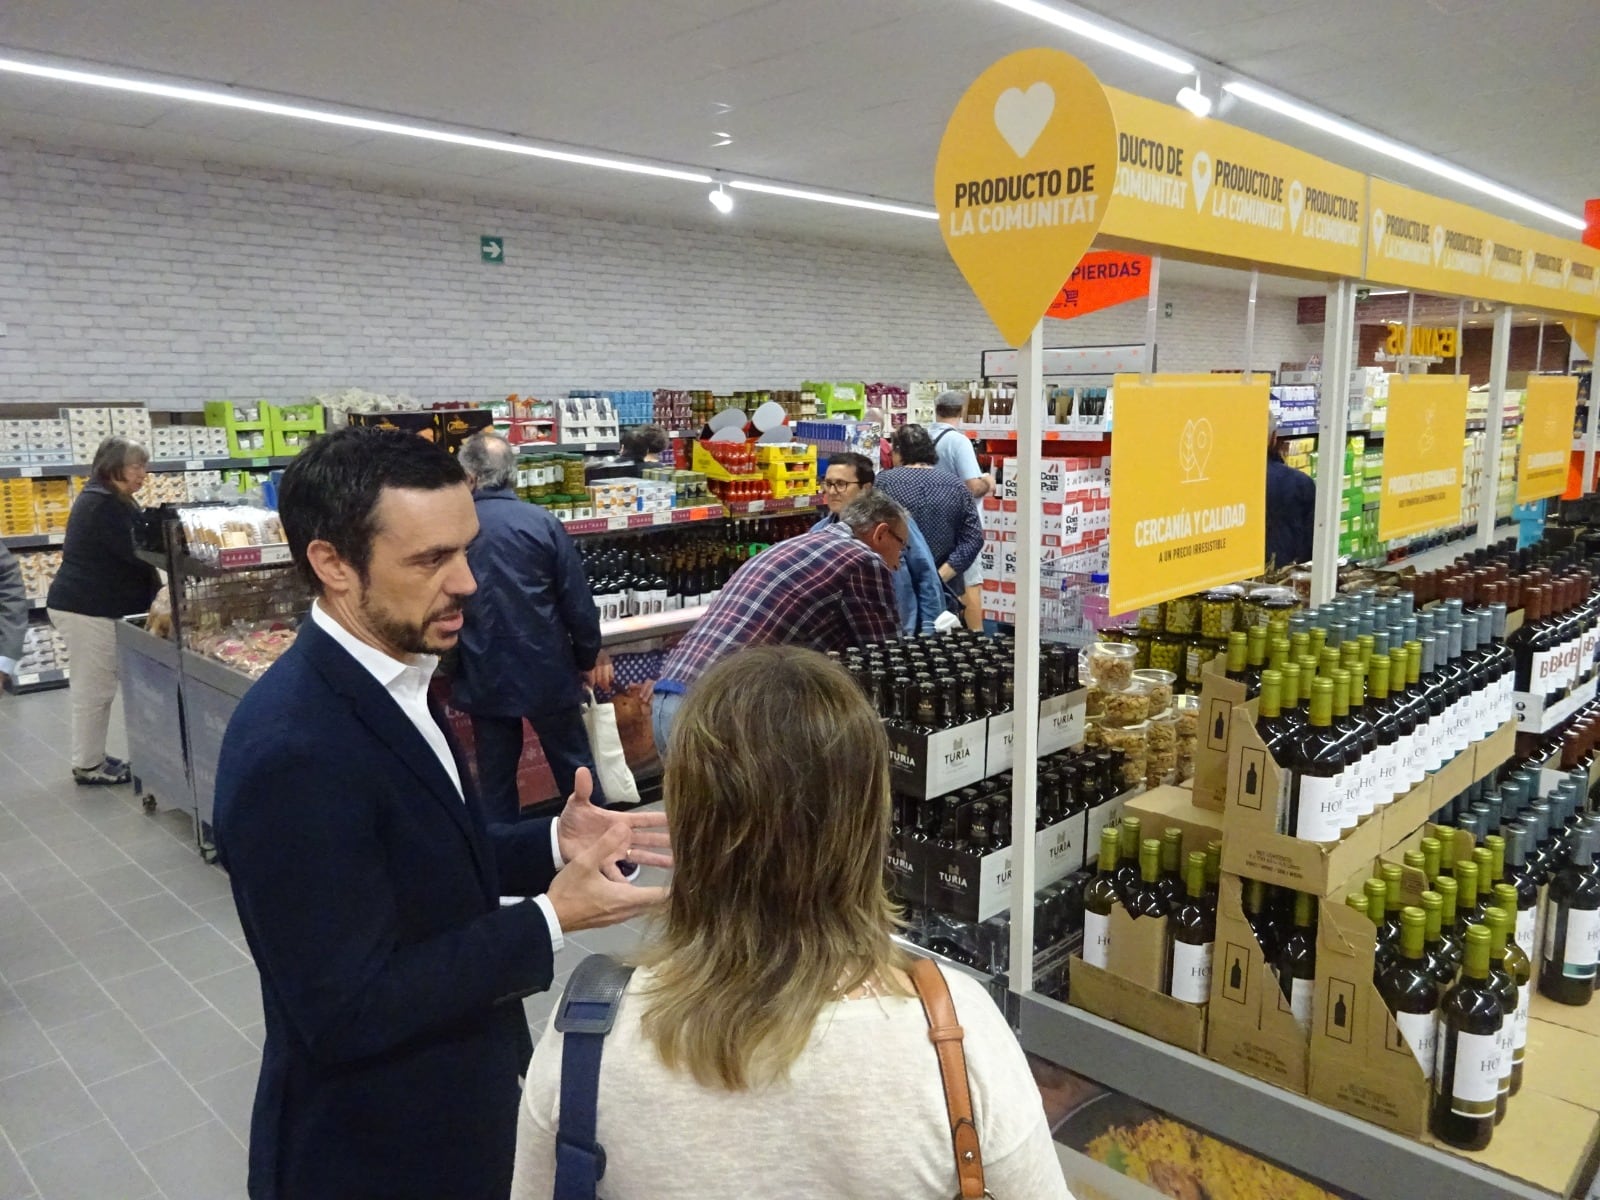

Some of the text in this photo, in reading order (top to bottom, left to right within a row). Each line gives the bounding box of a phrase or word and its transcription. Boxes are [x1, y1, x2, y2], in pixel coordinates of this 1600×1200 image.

[1166, 147, 1184, 177] DE
[955, 164, 1095, 209] PRODUCTO DE
[1214, 159, 1284, 203] PRODUCTO DE
[1212, 189, 1286, 231] LA COMUNITAT
[1305, 186, 1359, 223] PRODUCTO DE
[950, 194, 1099, 237] LA COMUNITAT
[1071, 260, 1142, 281] PIERDAS
[1065, 515, 1078, 524] Con
[1065, 525, 1078, 535] Par
[1135, 503, 1246, 548] CERCANÍA Y CALIDAD
[1164, 549, 1172, 562] UN
[1173, 545, 1192, 559] PRECIO
[1192, 538, 1227, 554] IRRESISTIBLE
[1053, 713, 1074, 728] TURIA
[889, 750, 916, 767] TURIA
[944, 748, 971, 765] TURIA
[1050, 840, 1071, 858] TURIA
[887, 855, 914, 873] TURIA
[938, 871, 968, 888] TURIA
